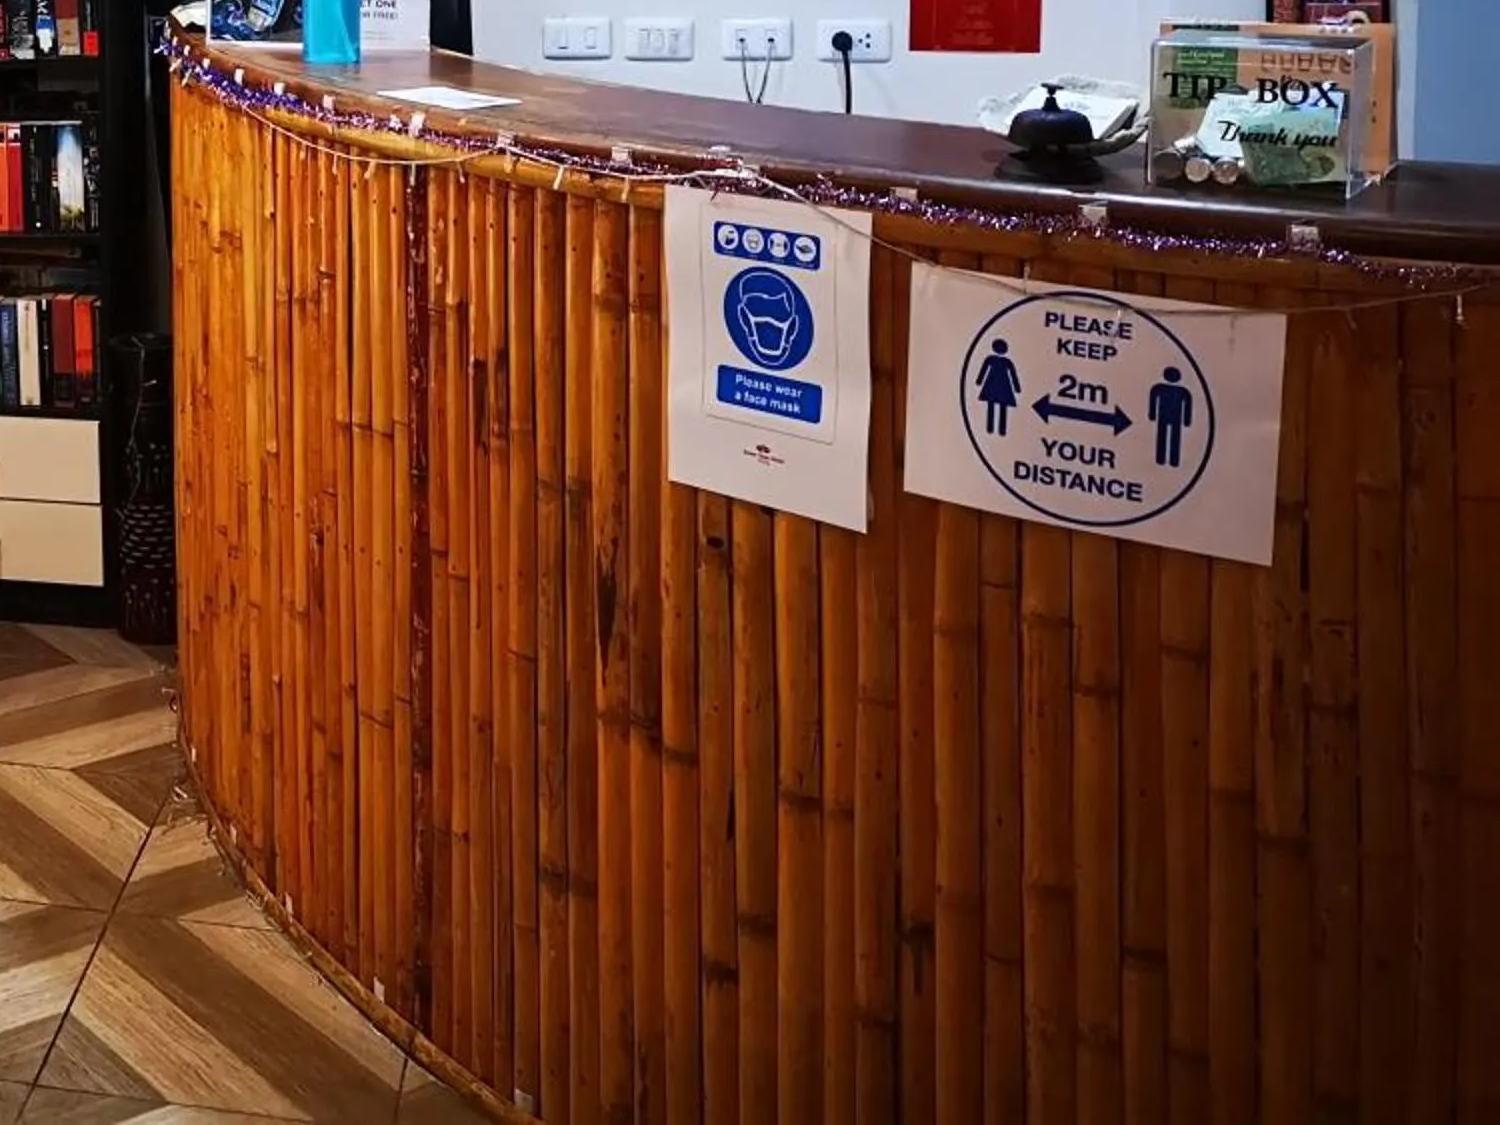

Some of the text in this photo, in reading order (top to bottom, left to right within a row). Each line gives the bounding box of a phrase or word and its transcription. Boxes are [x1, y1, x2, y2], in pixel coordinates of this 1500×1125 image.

[1162, 72, 1339, 109] TIP BOX
[1217, 120, 1338, 154] Thank you
[1044, 311, 1133, 340] PLEASE
[1056, 337, 1118, 362] KEEP
[735, 373, 803, 399] Please wear
[1057, 373, 1109, 405] 2m
[734, 390, 801, 415] a face mask
[1040, 437, 1116, 469] YOUR
[1013, 460, 1144, 503] DISTANCE
